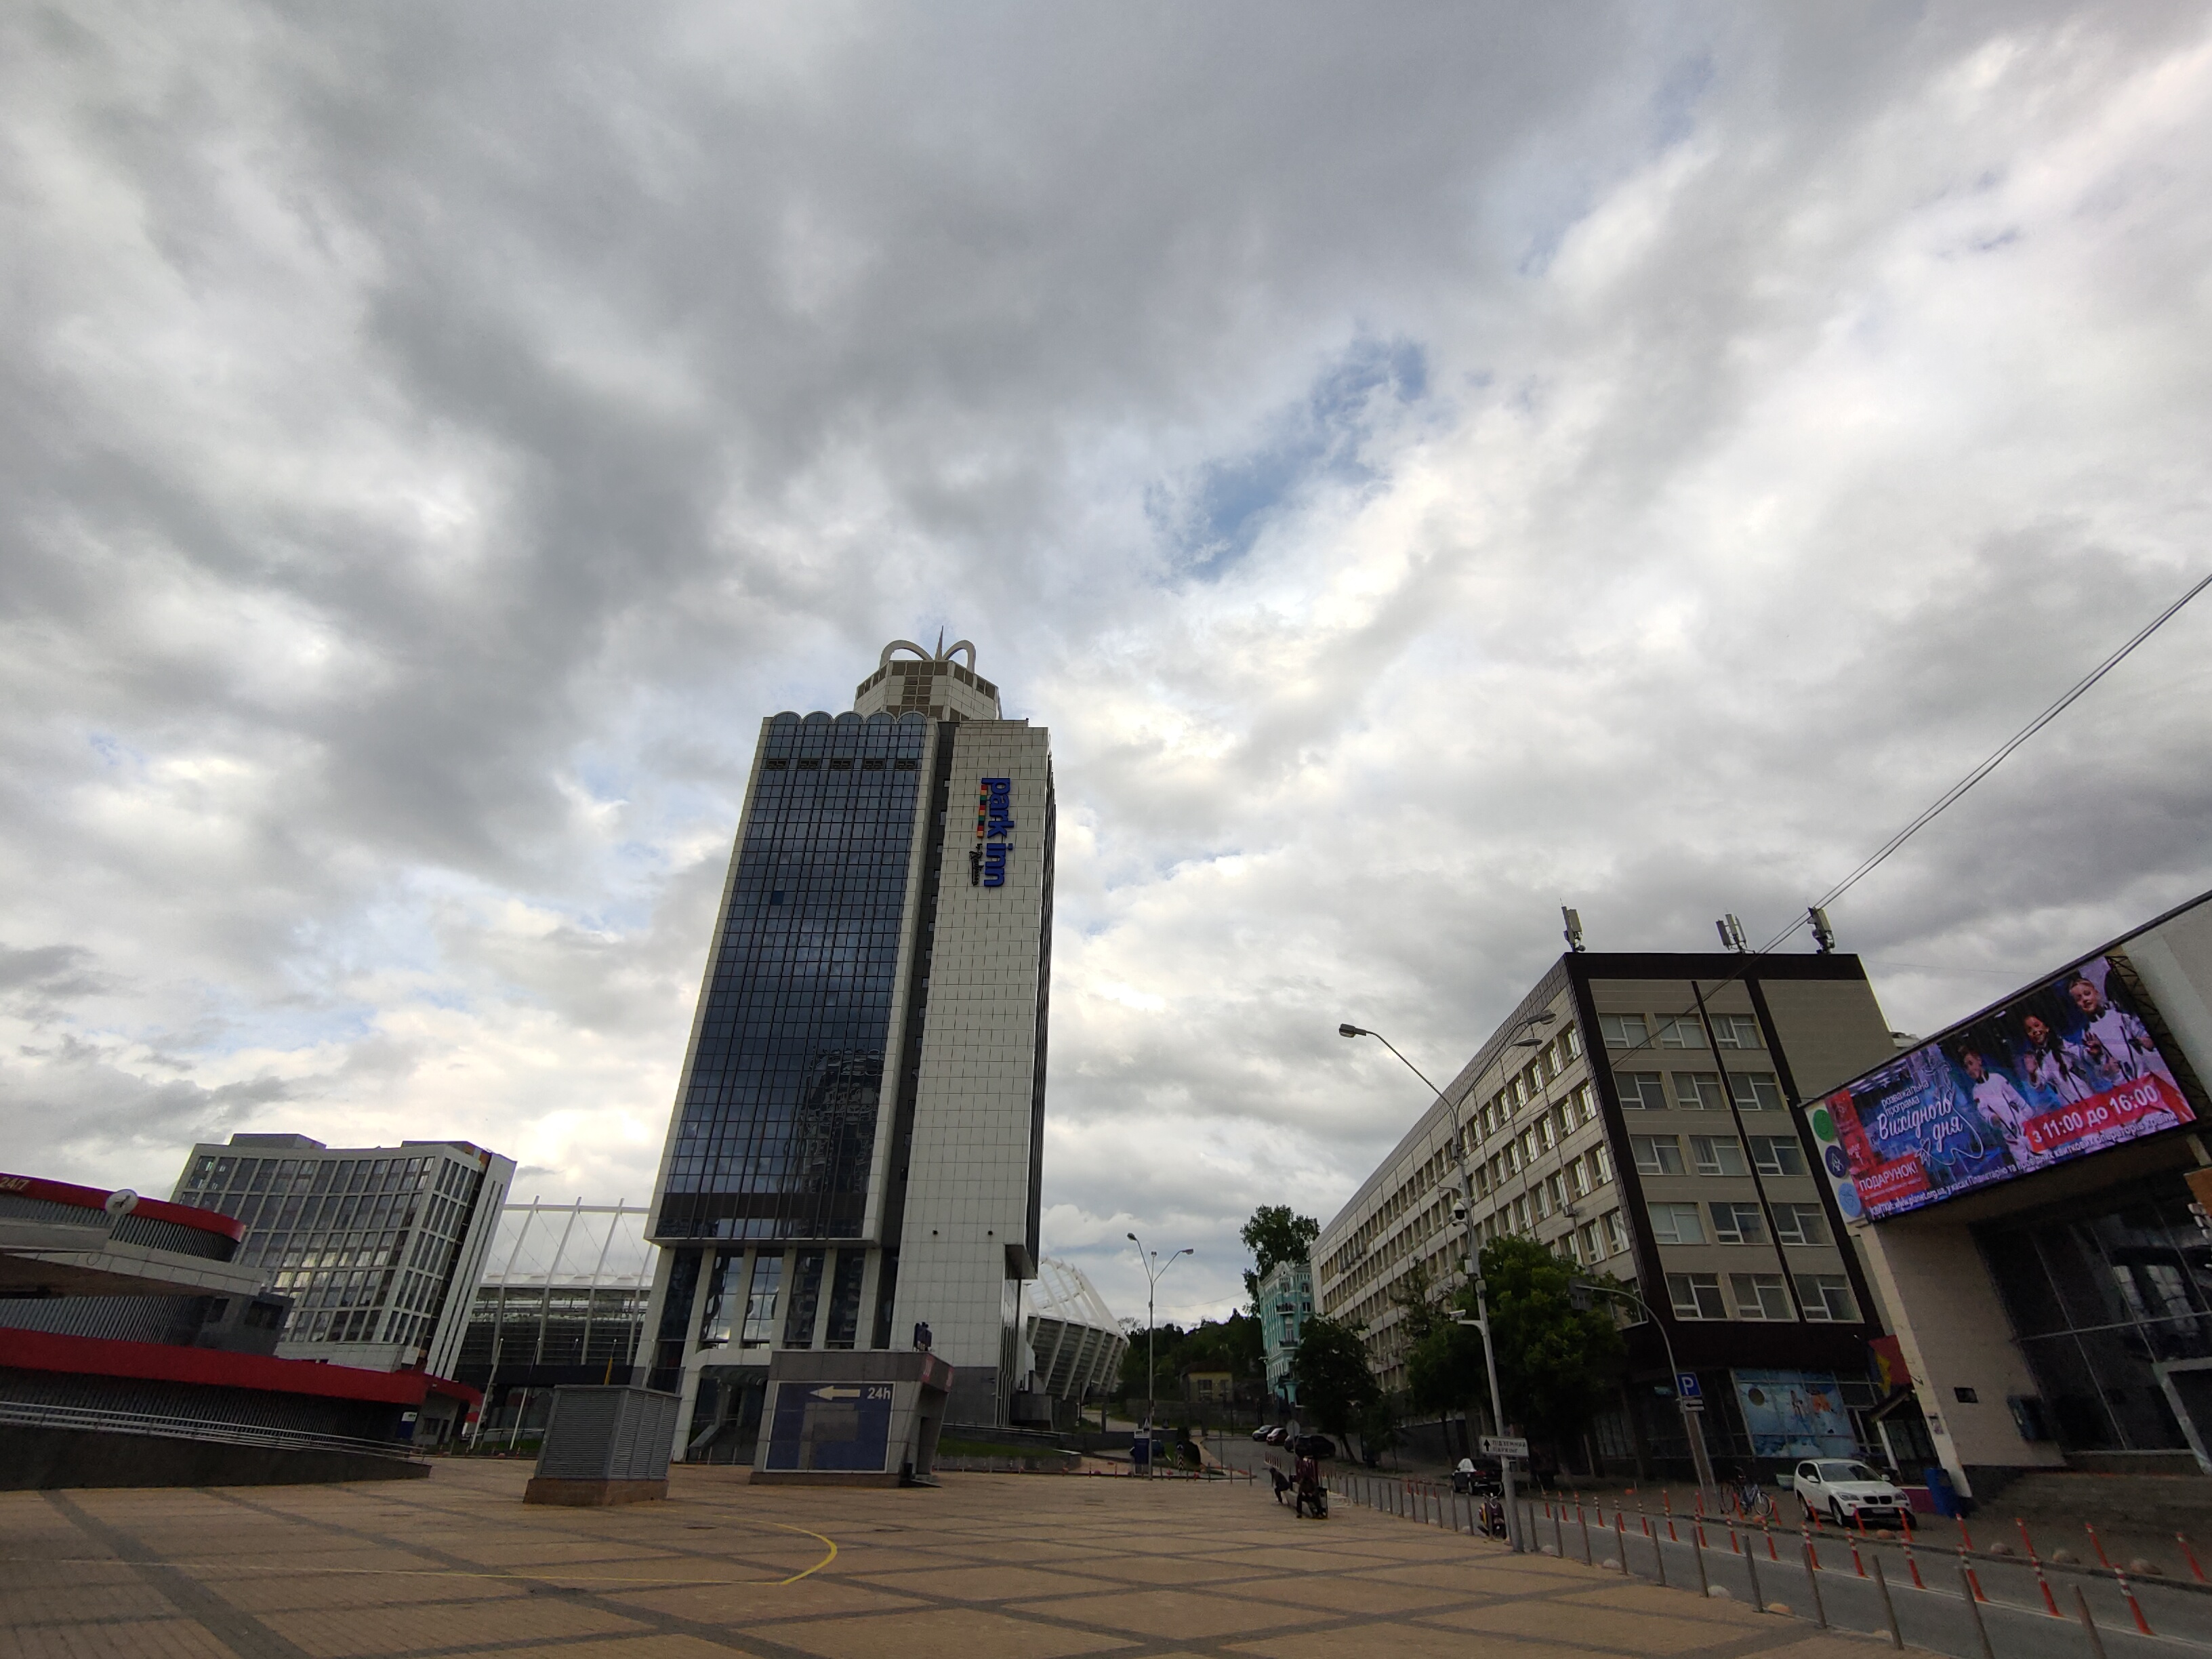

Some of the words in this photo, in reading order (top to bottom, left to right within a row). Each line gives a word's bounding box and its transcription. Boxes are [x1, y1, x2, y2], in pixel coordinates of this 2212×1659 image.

[981, 777, 1015, 838] park
[984, 843, 1013, 887] inn
[1881, 1080, 1929, 1109] розважальна
[1885, 1095, 1920, 1117] програма
[1877, 1096, 1953, 1140] Вихідного
[2043, 1111, 2083, 1139] 11:00
[2087, 1107, 2108, 1128] до
[2110, 1084, 2158, 1114] 16:00
[1933, 1116, 1963, 1152] дня
[1859, 1161, 1918, 1192] ПОДАРУНОК!
[867, 1387, 890, 1399] 24h
[1681, 1376, 1694, 1395] P
